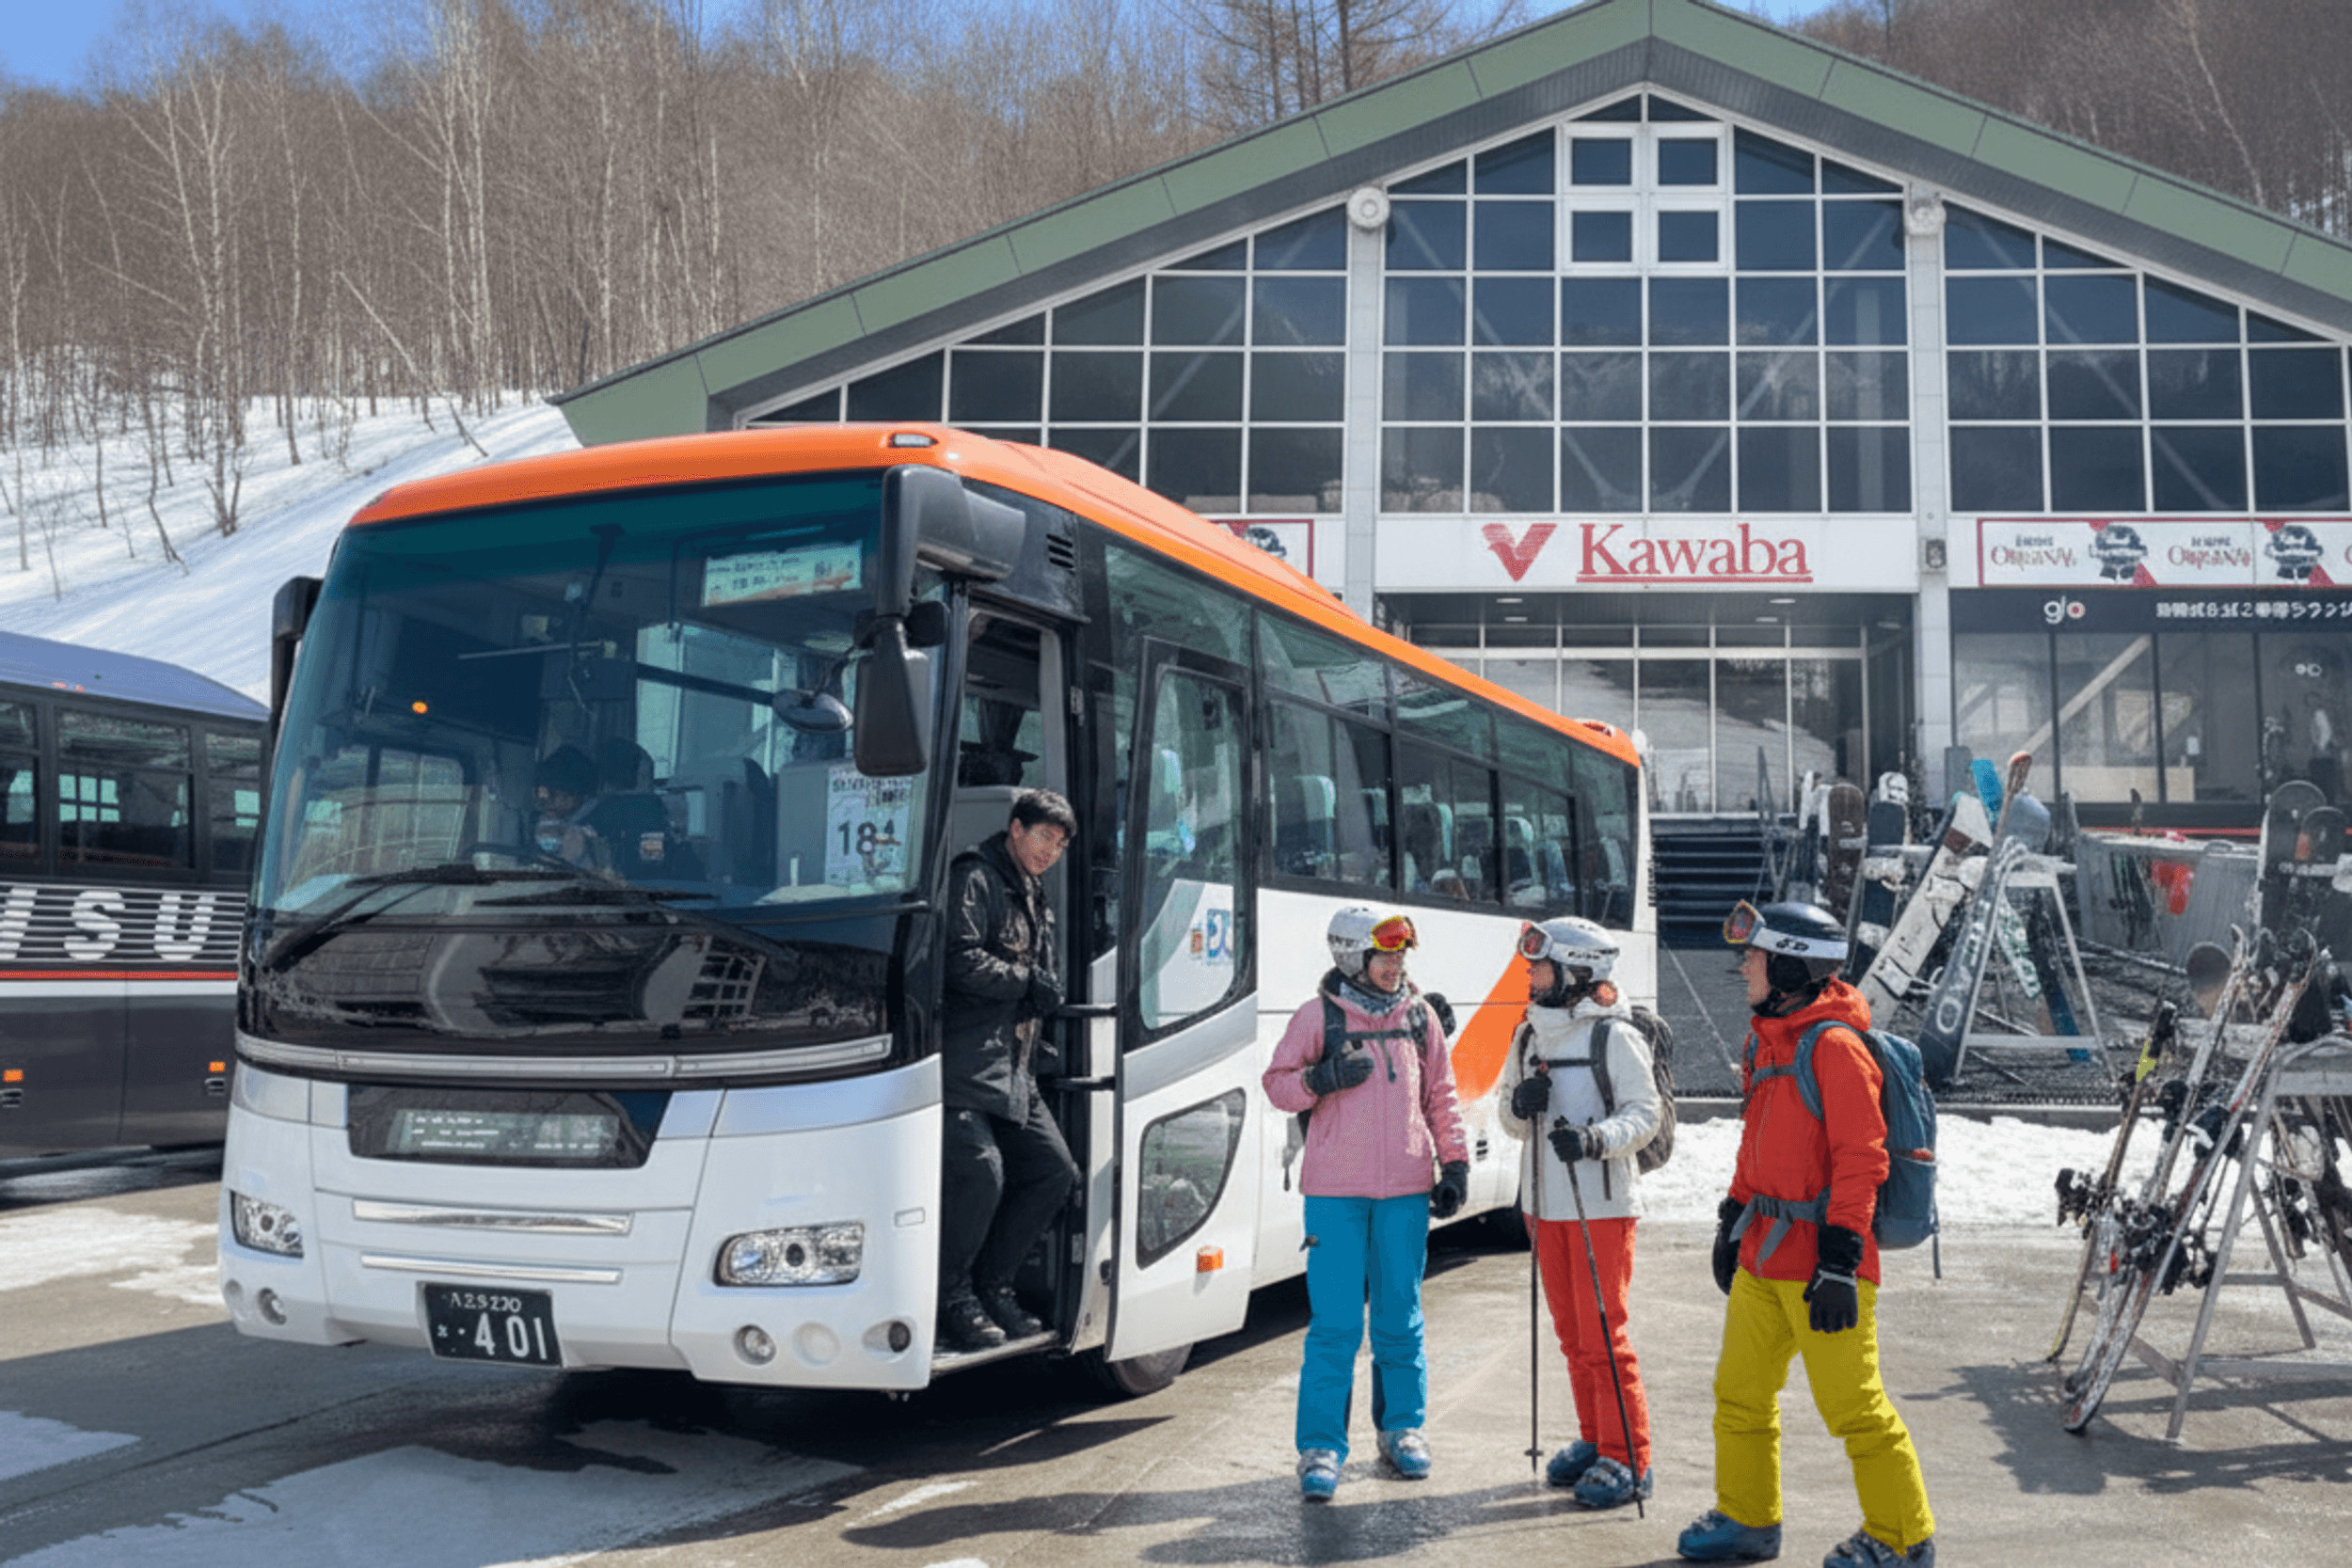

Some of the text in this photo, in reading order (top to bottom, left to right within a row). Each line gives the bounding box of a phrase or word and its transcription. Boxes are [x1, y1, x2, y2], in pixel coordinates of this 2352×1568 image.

[1579, 522, 1812, 576] Kawaba
[2043, 594, 2086, 625] glo
[474, 1312, 548, 1360] 401
